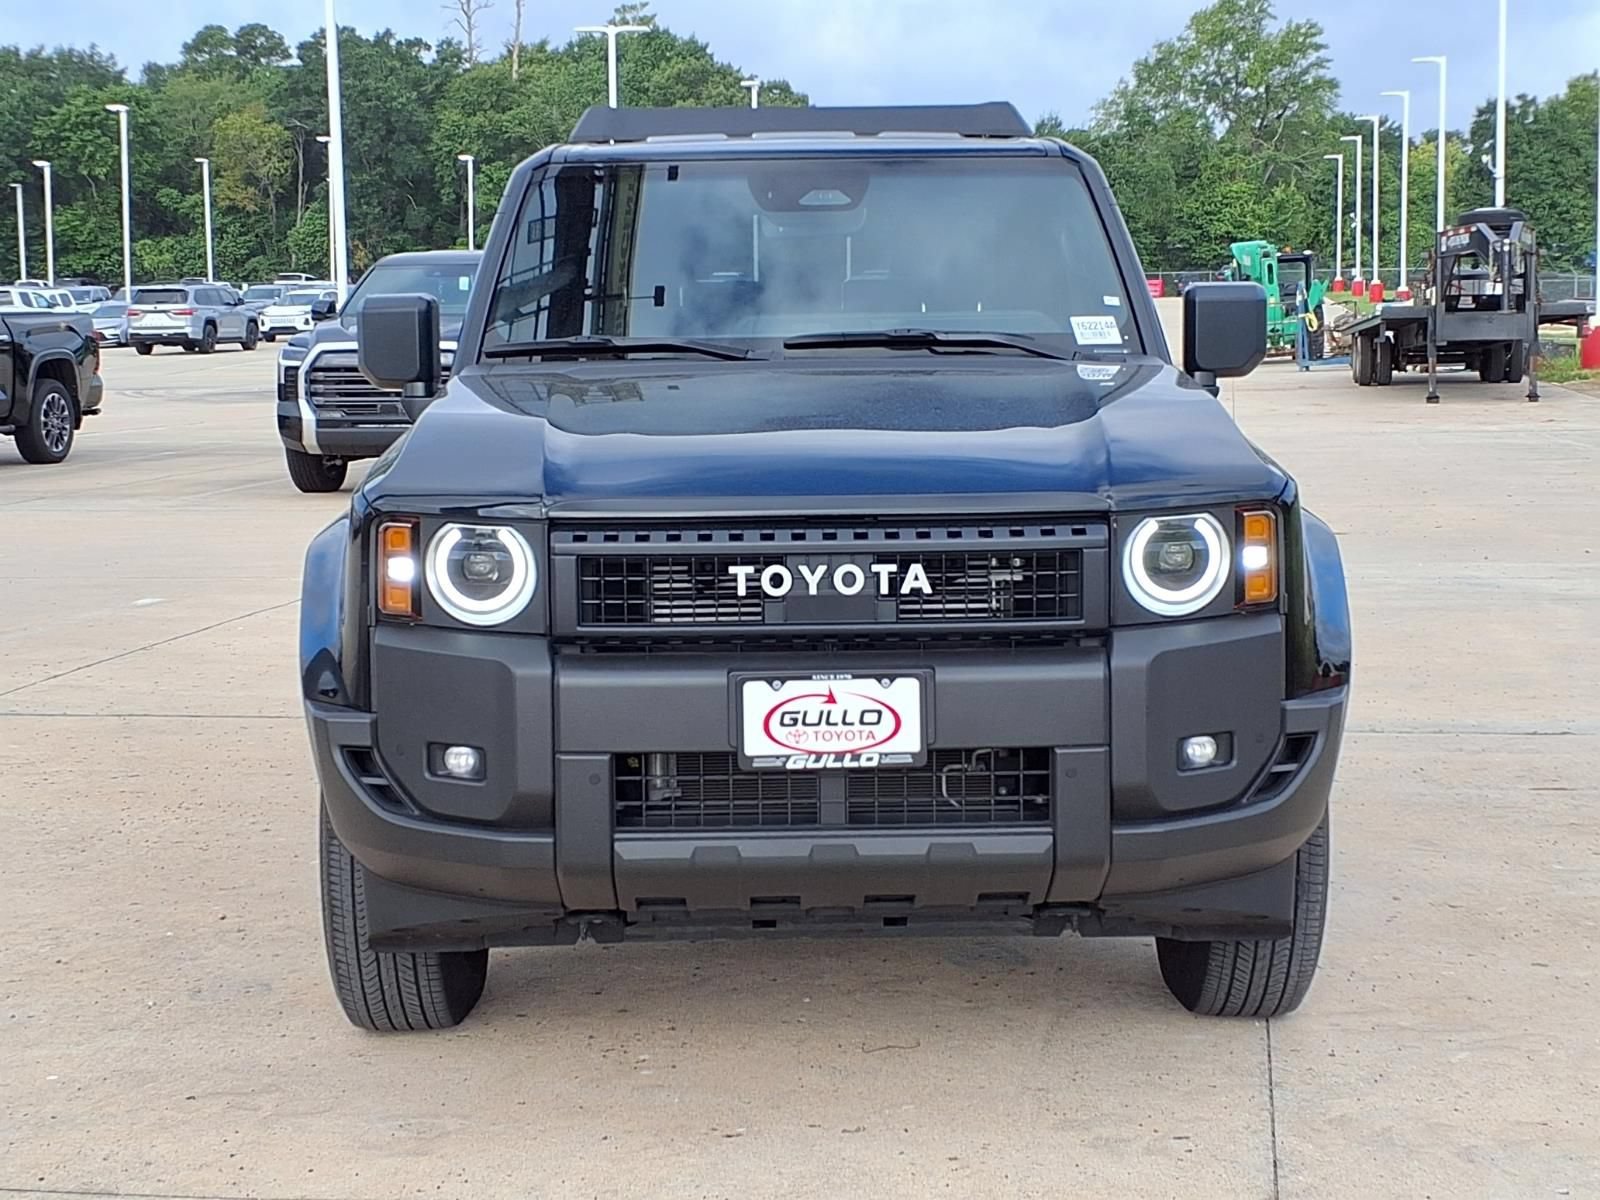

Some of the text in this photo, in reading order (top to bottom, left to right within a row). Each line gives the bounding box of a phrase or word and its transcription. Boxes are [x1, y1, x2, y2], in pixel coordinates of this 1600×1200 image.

[728, 563, 933, 597] TOYOTA
[779, 709, 883, 727] GULLO
[813, 729, 877, 742] TOYOTA
[785, 753, 880, 770] GULLO
